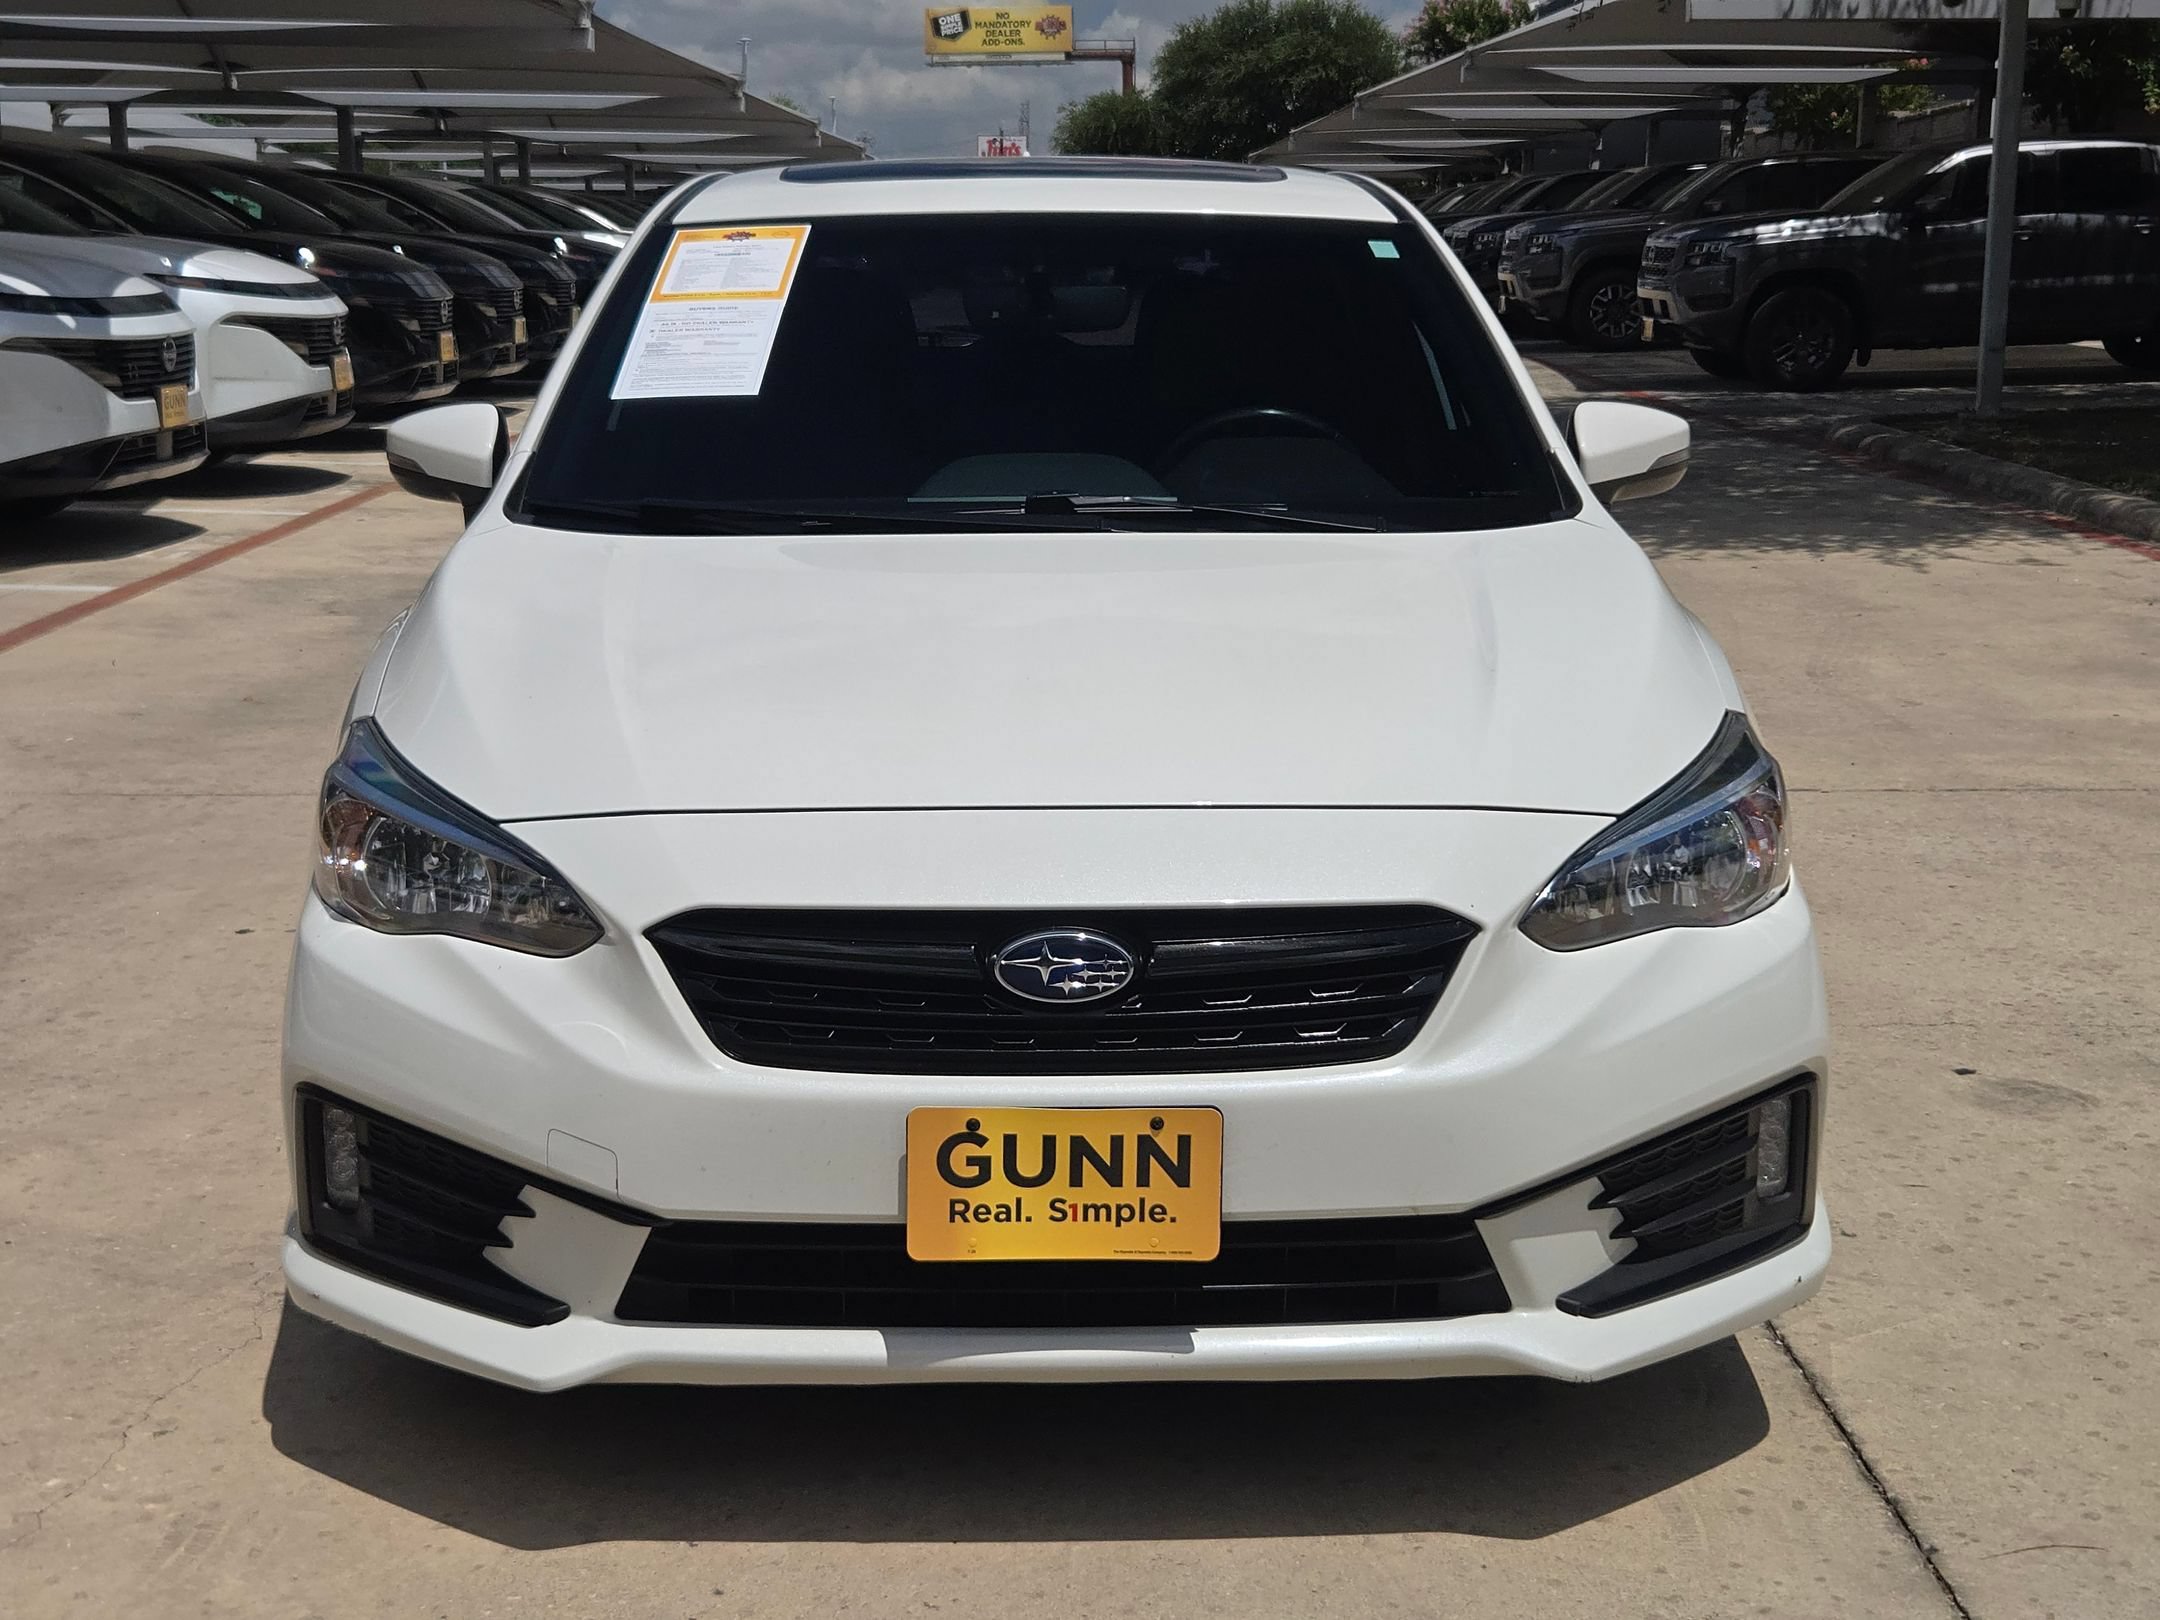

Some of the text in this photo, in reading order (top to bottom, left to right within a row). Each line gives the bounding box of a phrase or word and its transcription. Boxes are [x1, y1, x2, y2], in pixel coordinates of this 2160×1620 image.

[938, 13, 961, 25] ONE
[996, 12, 1010, 20] NO
[975, 20, 1031, 29] MANDATORY
[941, 27, 963, 36] PRICE
[985, 30, 1020, 38] DEALER
[981, 38, 1025, 47] ADD-ONS.
[164, 393, 187, 409] GUNN
[936, 1131, 1192, 1188] GUNN
[949, 1197, 1032, 1223] Real.
